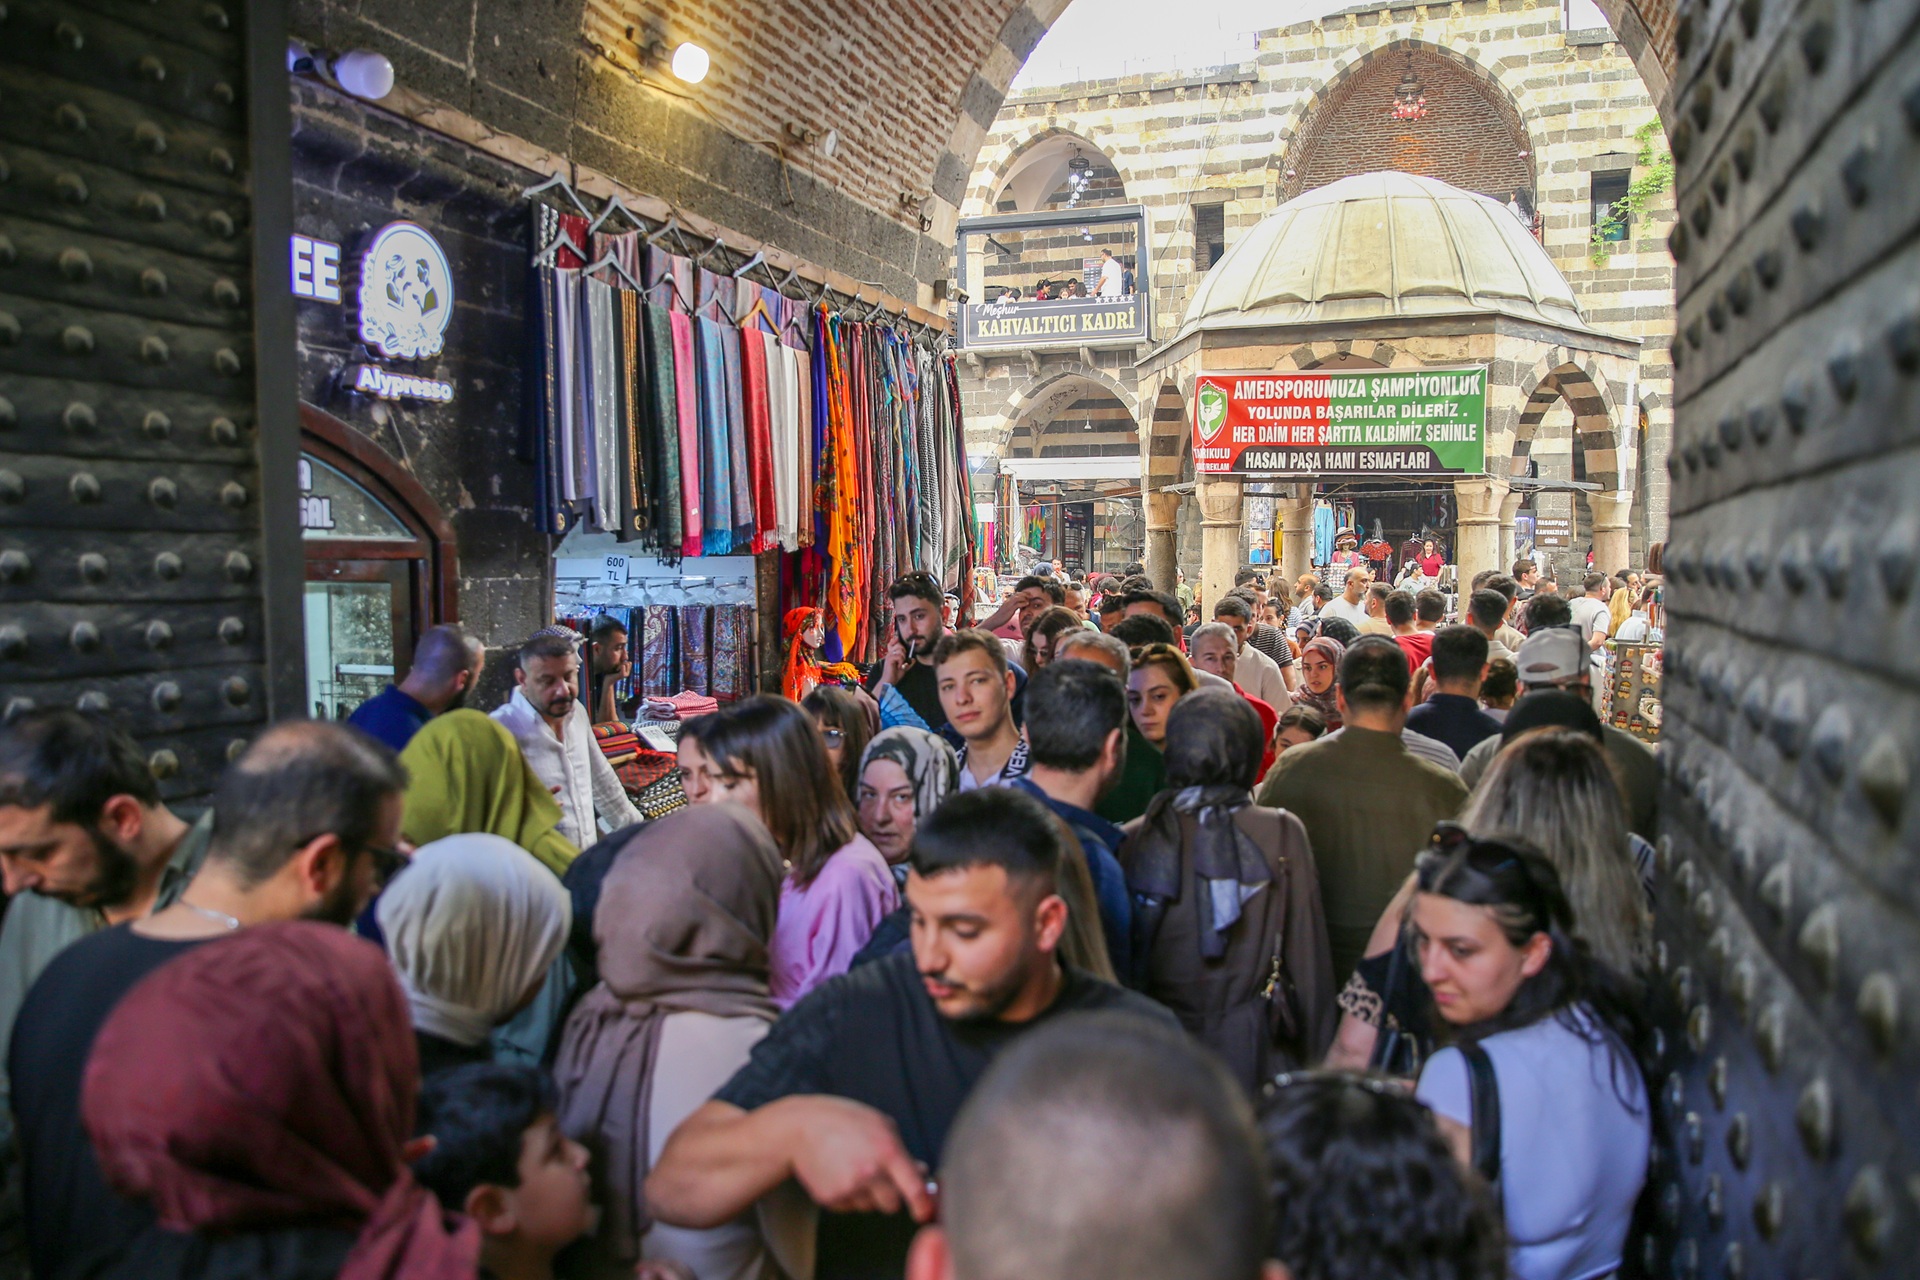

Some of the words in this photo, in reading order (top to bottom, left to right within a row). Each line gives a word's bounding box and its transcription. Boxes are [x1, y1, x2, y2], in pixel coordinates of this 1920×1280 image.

[975, 303, 1020, 319] Meşhur
[978, 313, 1077, 338] KAHVALTICI
[1081, 306, 1136, 332] KADRİ
[358, 366, 453, 402] Alypresso
[1233, 378, 1367, 400] AMEDSPORUMUZA
[1371, 372, 1481, 402] ŞAMPİYONLUK
[1247, 406, 1311, 419] YOLUNDA
[1316, 404, 1396, 422] BAŞARILAR
[1401, 400, 1459, 418] DİLERİZ
[1233, 426, 1255, 443] HER
[1258, 422, 1288, 443] DAİM
[1291, 426, 1315, 443] HER
[1318, 425, 1362, 446] ŞARTTA
[1365, 421, 1422, 442] KALBİMİZ
[1426, 420, 1477, 442] SENİNLE
[1245, 452, 1286, 469] HASAN
[1289, 452, 1321, 473] PAŞA
[1325, 452, 1356, 469] HANI
[1359, 451, 1431, 469] ESNAFLARI
[606, 556, 625, 568] 600
[608, 570, 620, 581] TL
